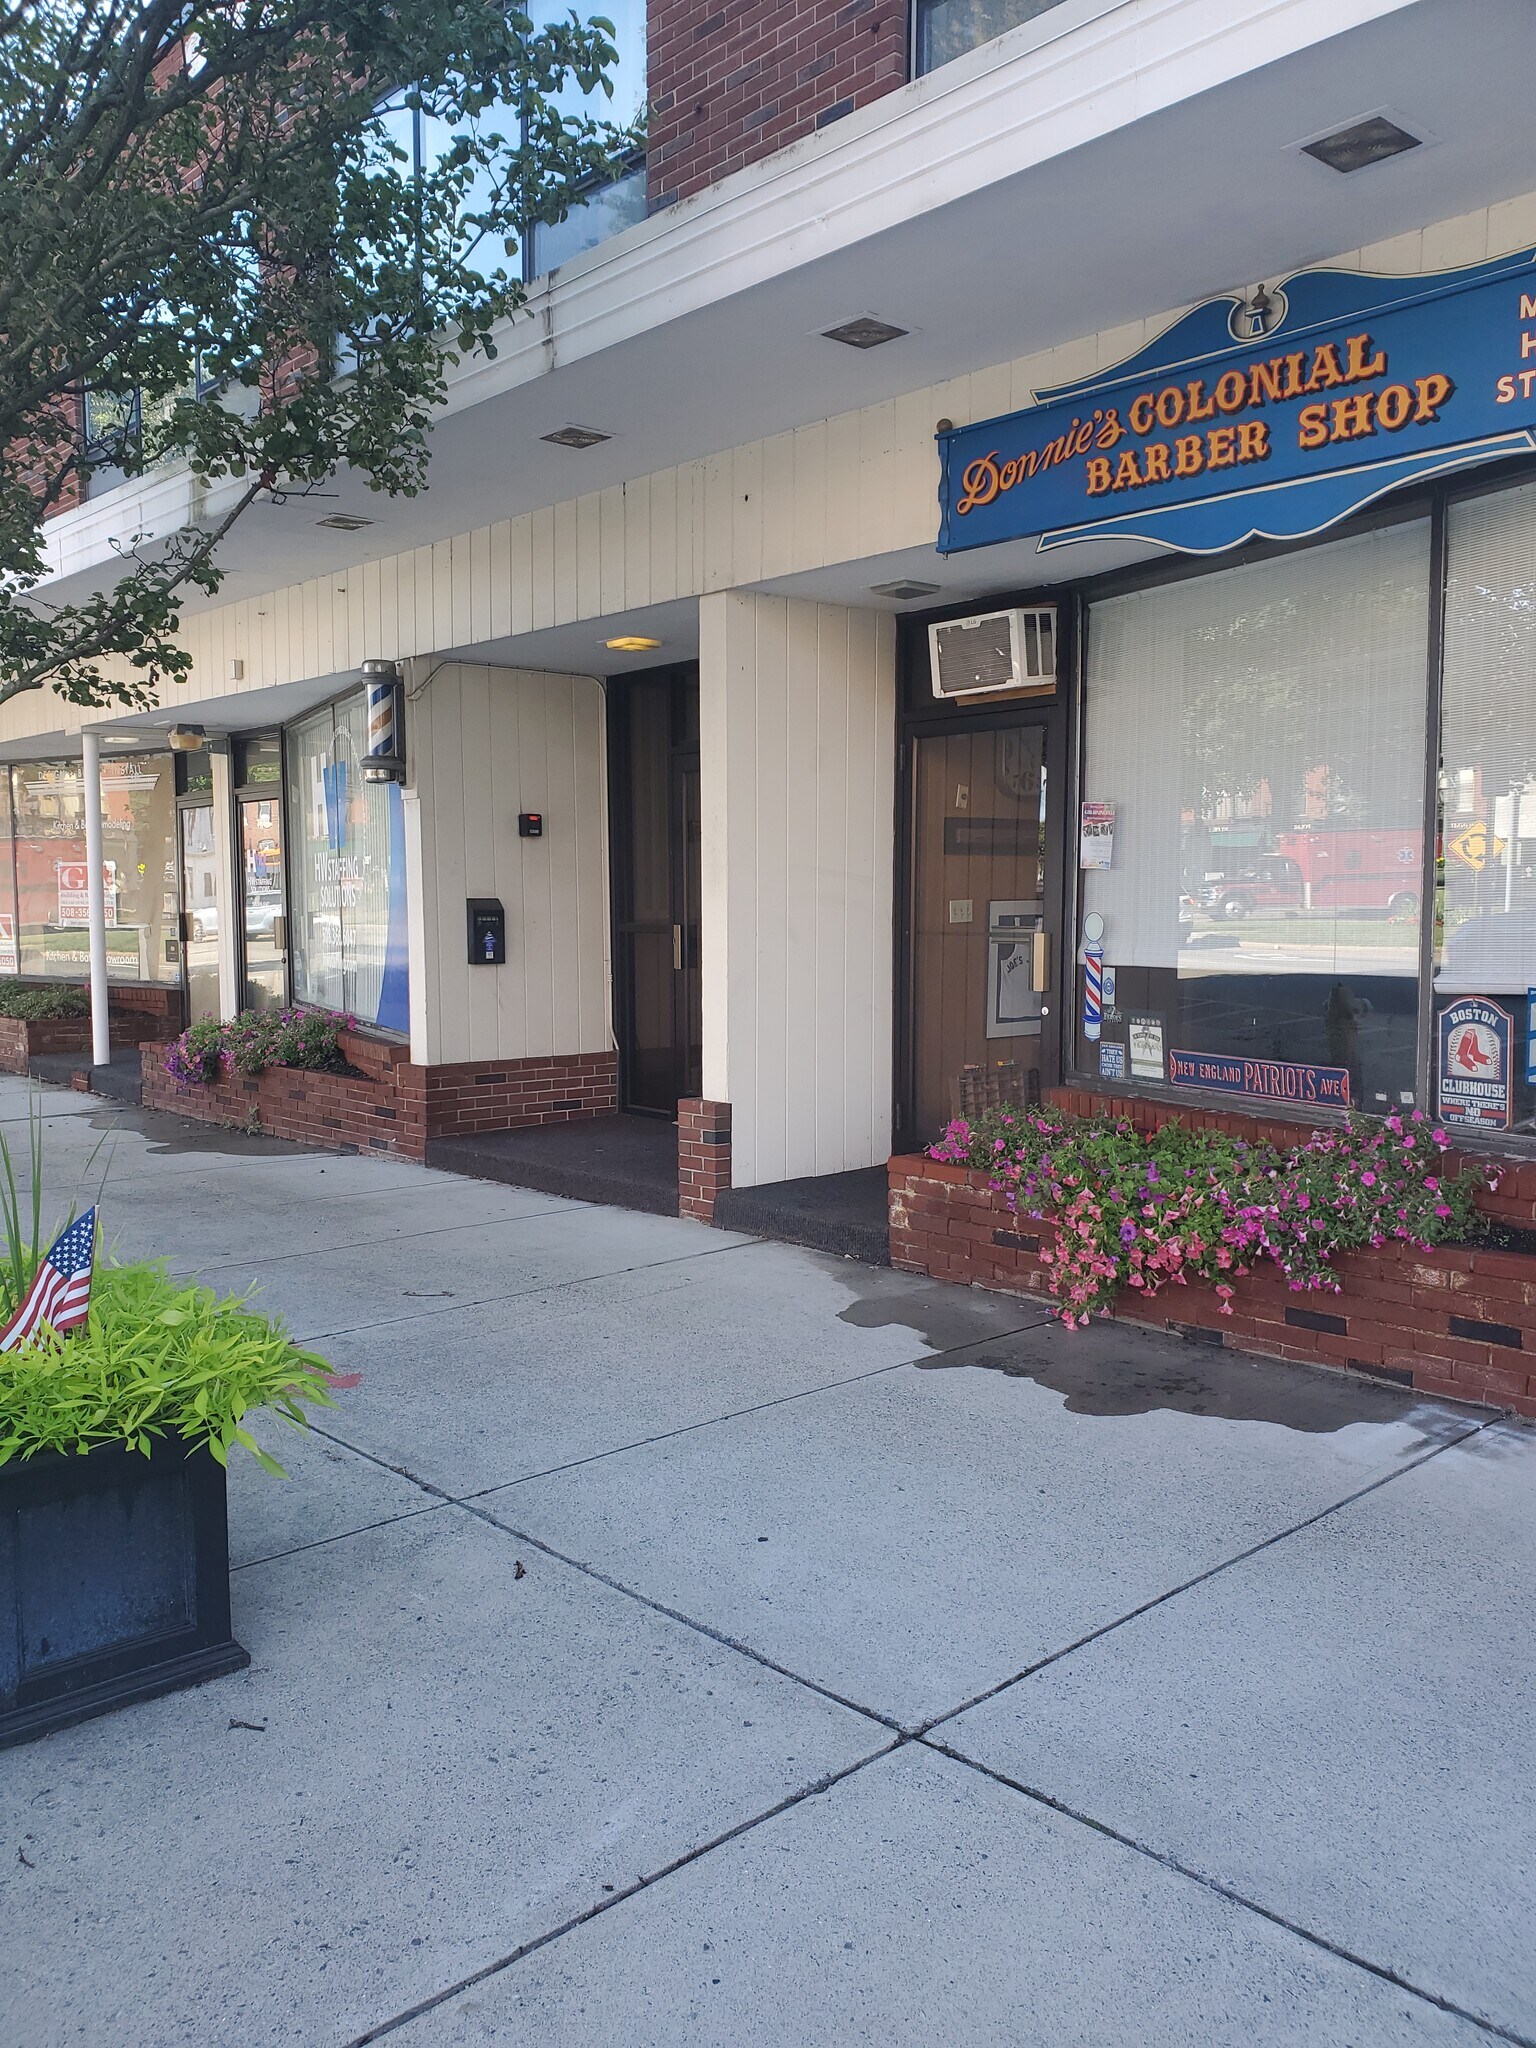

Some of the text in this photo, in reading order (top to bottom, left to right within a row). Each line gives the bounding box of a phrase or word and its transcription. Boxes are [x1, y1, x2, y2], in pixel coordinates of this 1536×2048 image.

[956, 333, 1387, 516] Donnie's COLONIAL
[1086, 372, 1454, 498] BARBER SHOP
[53, 819, 74, 831] Kitchen
[320, 885, 356, 908] SOLUTIONS
[45, 949, 71, 963] Kitchen
[71, 950, 79, 961] &
[1007, 956, 1023, 973] JOE'S
[1449, 1008, 1499, 1027] BOSTON
[1101, 1054, 1116, 1063] HATE
[1116, 1055, 1123, 1064] US
[1116, 1069, 1123, 1078] US
[1177, 1060, 1195, 1076] NEW
[1199, 1063, 1241, 1083] ENGLAND
[1243, 1062, 1316, 1101] PATRIOTS
[1320, 1078, 1340, 1097] AVE
[1442, 1078, 1506, 1099] CLUBHOUSE
[1442, 1096, 1505, 1111] WHERE THERE'S
[1464, 1106, 1481, 1117] NO
[1449, 1113, 1497, 1127] OFFSEASON
